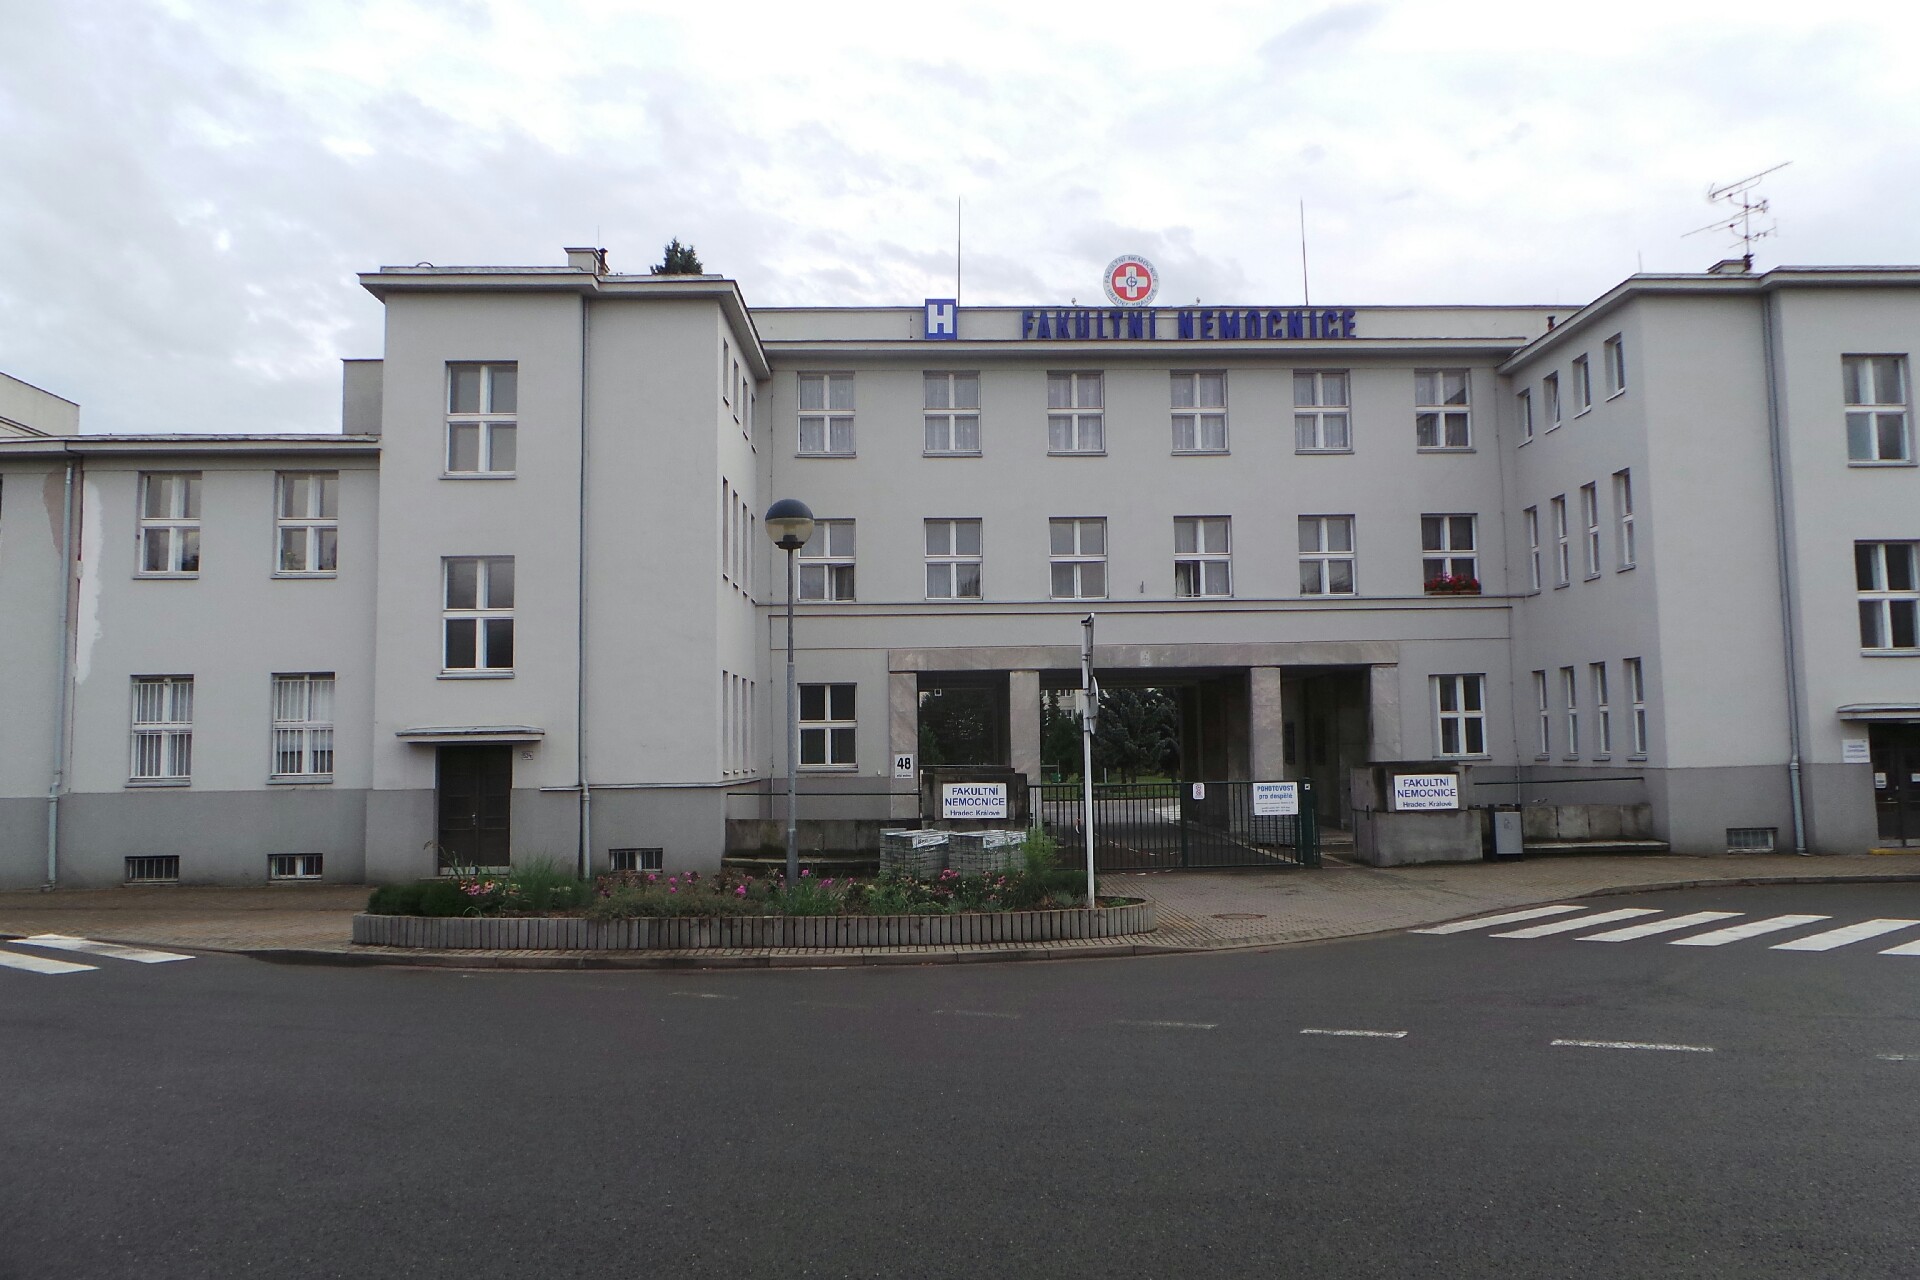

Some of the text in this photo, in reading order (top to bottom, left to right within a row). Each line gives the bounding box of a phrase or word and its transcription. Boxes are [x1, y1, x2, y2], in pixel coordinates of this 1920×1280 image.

[928, 304, 953, 334] H
[1177, 309, 1357, 340] NEMOCNICE
[897, 757, 911, 770] 48
[1403, 776, 1449, 788] FAKULTNÍ
[952, 785, 999, 796] FAKULTNÍ
[1397, 788, 1457, 798] NEMOCNICE
[945, 797, 1005, 807] NEMOCNICE
